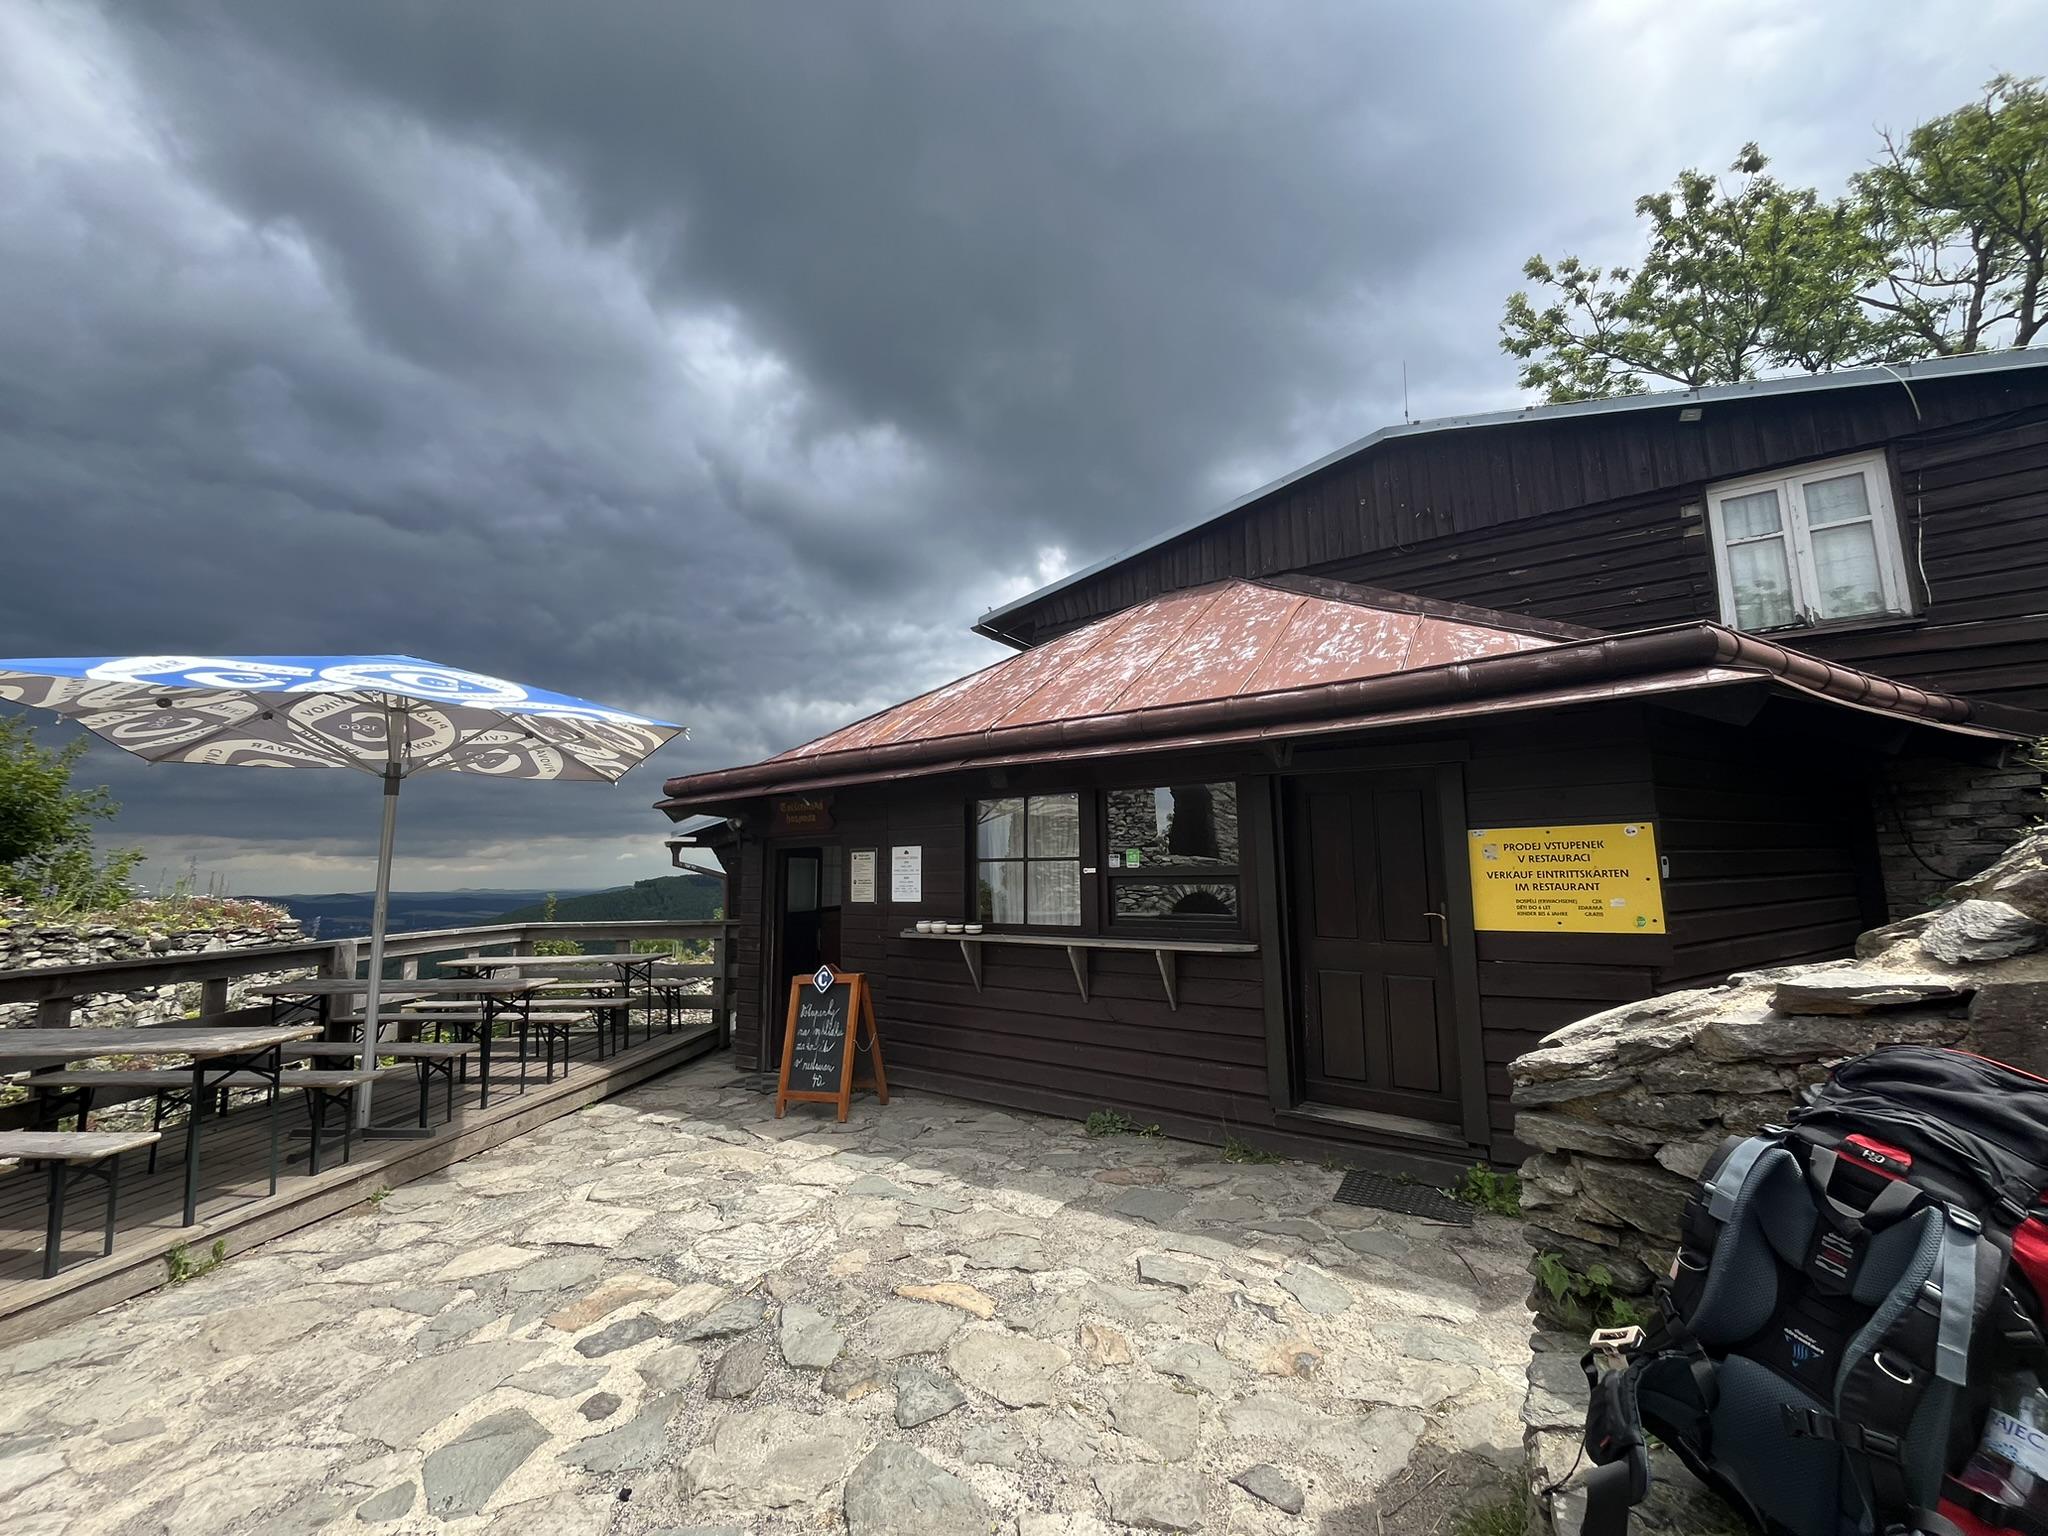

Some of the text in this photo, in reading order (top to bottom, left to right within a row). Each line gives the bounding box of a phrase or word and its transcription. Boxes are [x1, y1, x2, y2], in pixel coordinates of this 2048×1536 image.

[1503, 840, 1605, 851] PRODEJ VSTUPENEK
[1517, 853, 1591, 863] V RESTAURACI
[1486, 869, 1629, 879] VERKAUF EINTRITTSKARTEN
[1515, 882, 1600, 891] IM RESTAURANT
[817, 971, 828, 987] C
